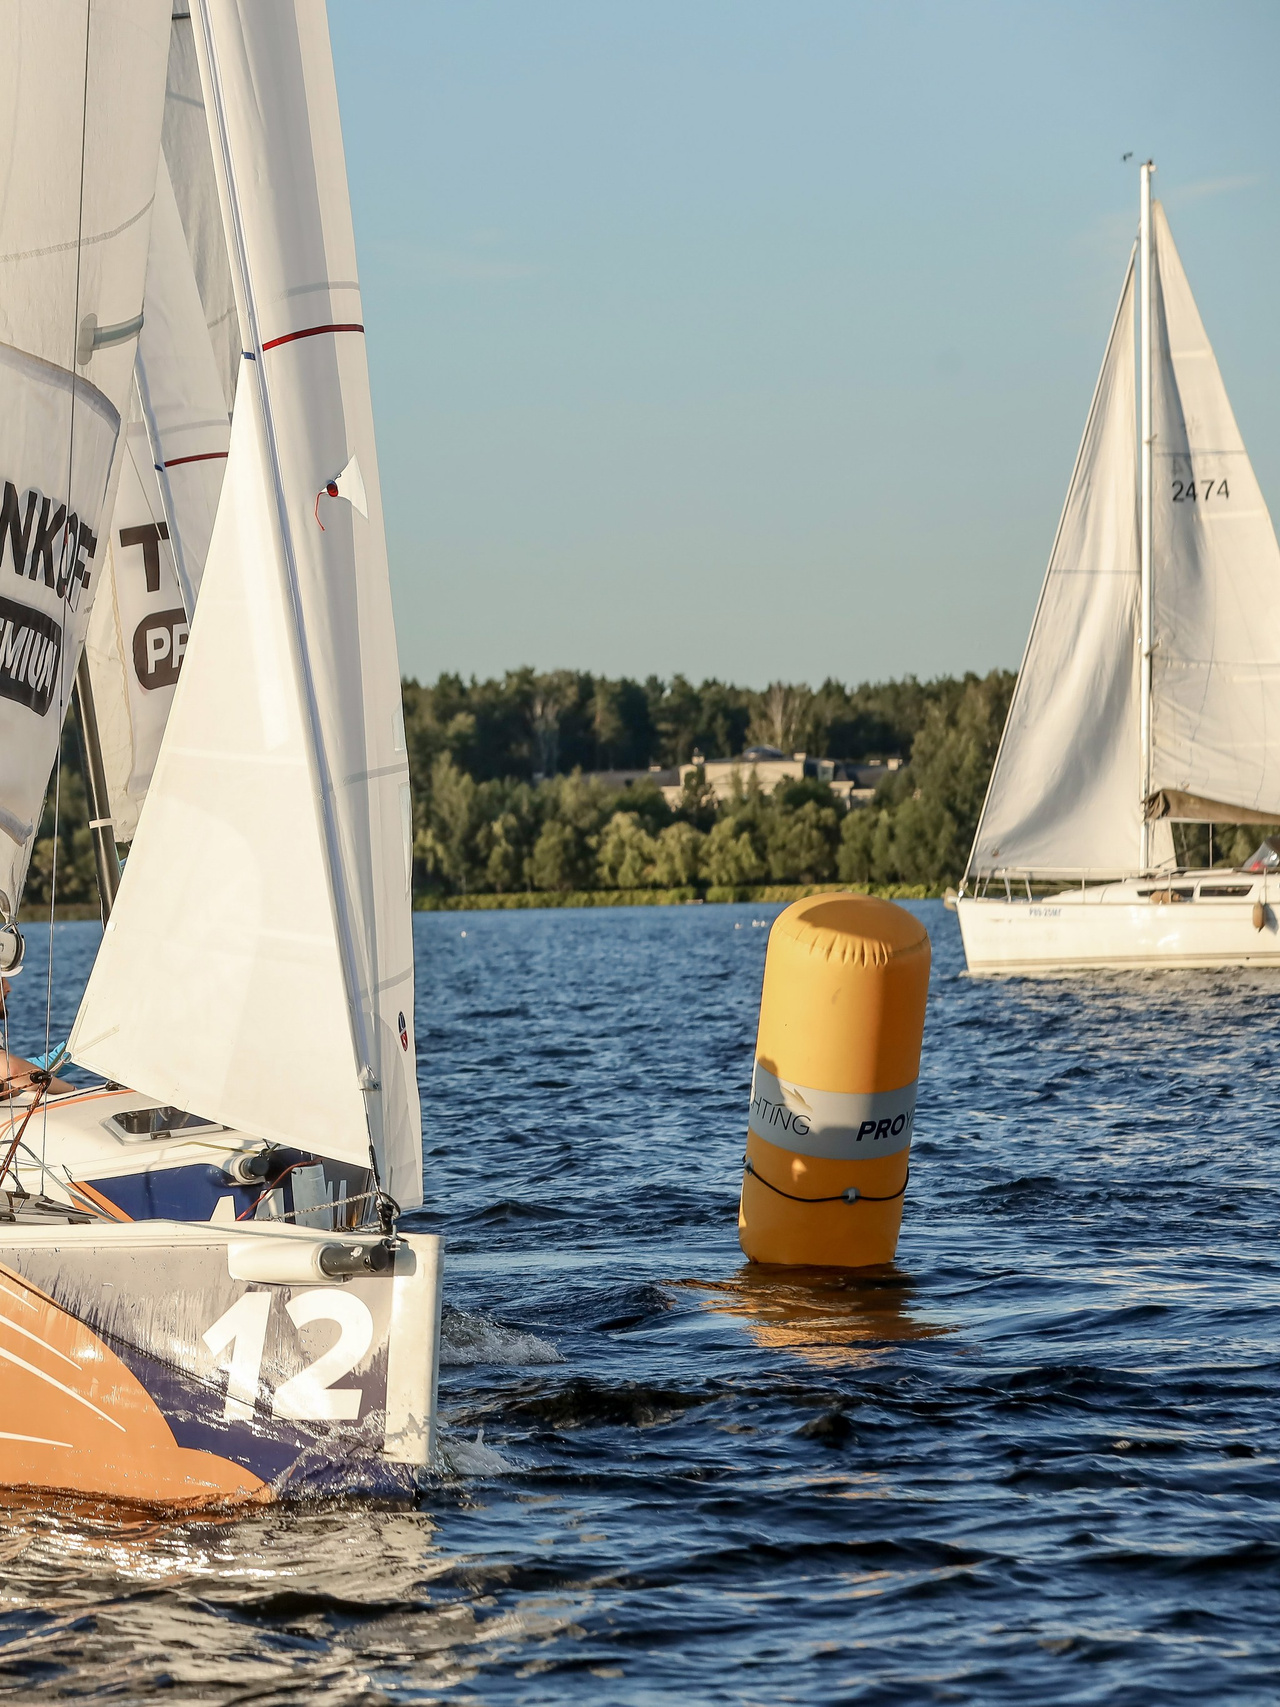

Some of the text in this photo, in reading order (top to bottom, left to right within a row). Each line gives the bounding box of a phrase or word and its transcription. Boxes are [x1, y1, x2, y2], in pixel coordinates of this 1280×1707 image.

[1171, 478, 1230, 502] 2474
[751, 1089, 915, 1142] HTING PROY
[201, 1288, 374, 1421] 12
